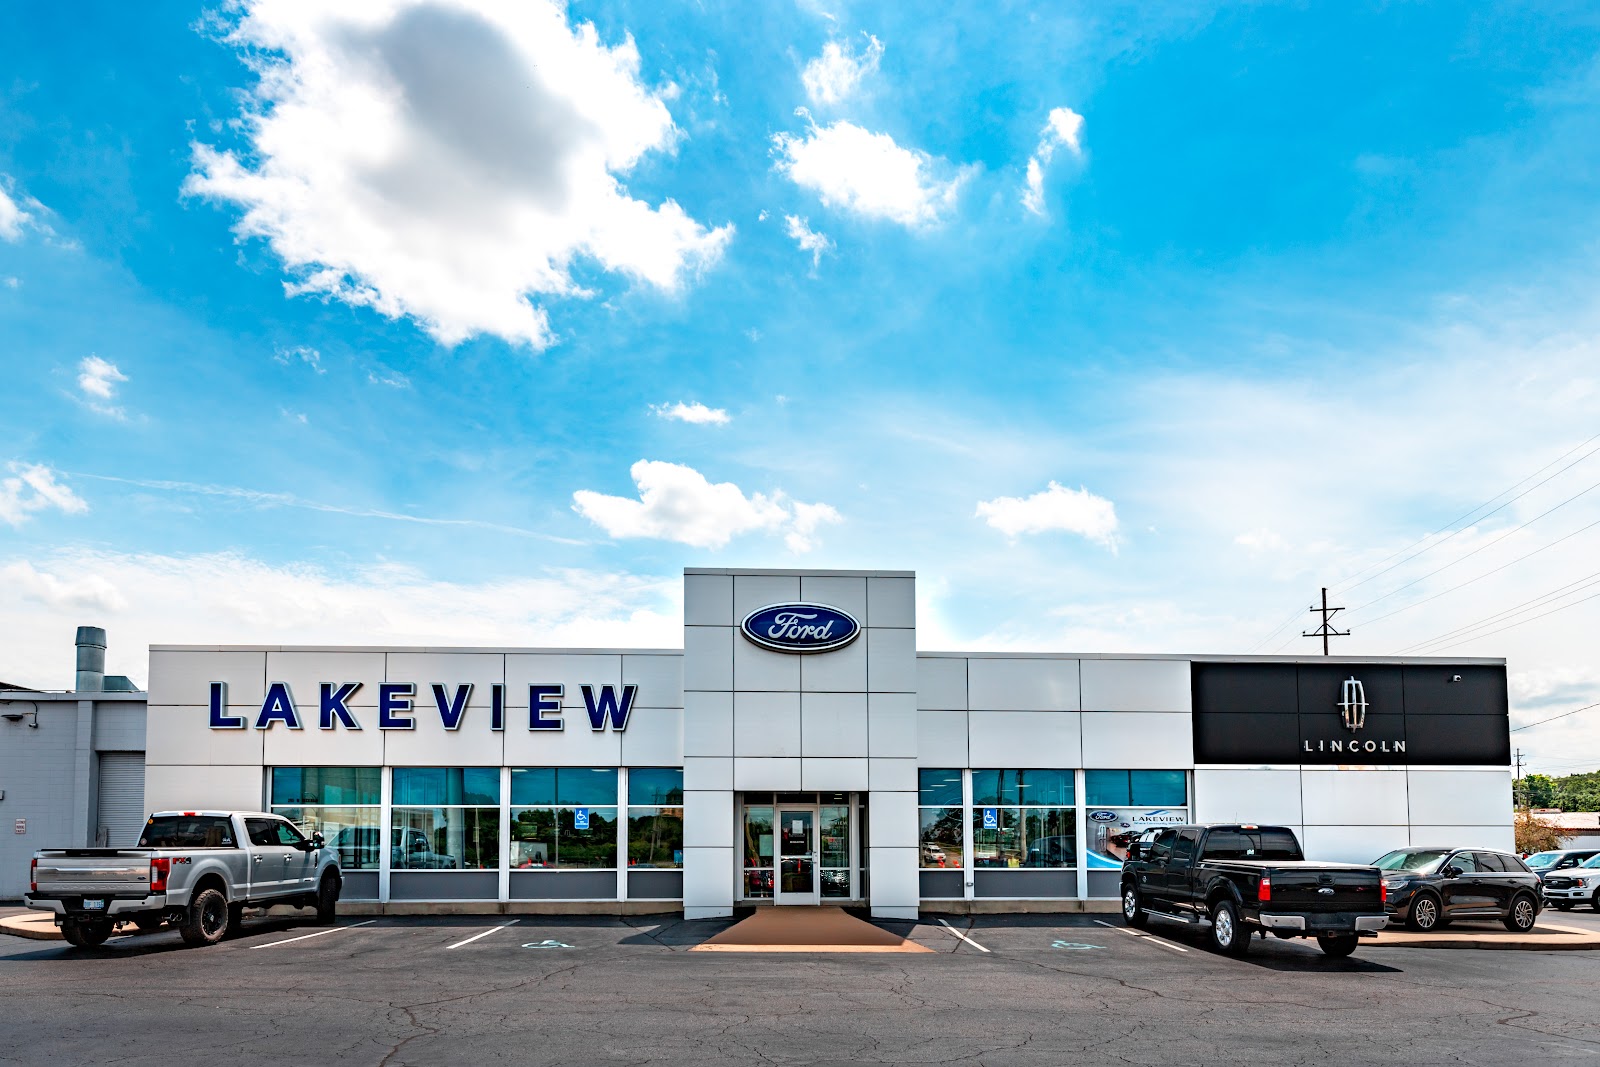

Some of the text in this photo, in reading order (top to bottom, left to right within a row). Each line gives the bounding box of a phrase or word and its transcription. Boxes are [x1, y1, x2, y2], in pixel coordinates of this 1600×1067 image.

[768, 612, 834, 639] Ford
[208, 681, 638, 732] LAKEVIEW
[1304, 740, 1406, 752] LINCOLN
